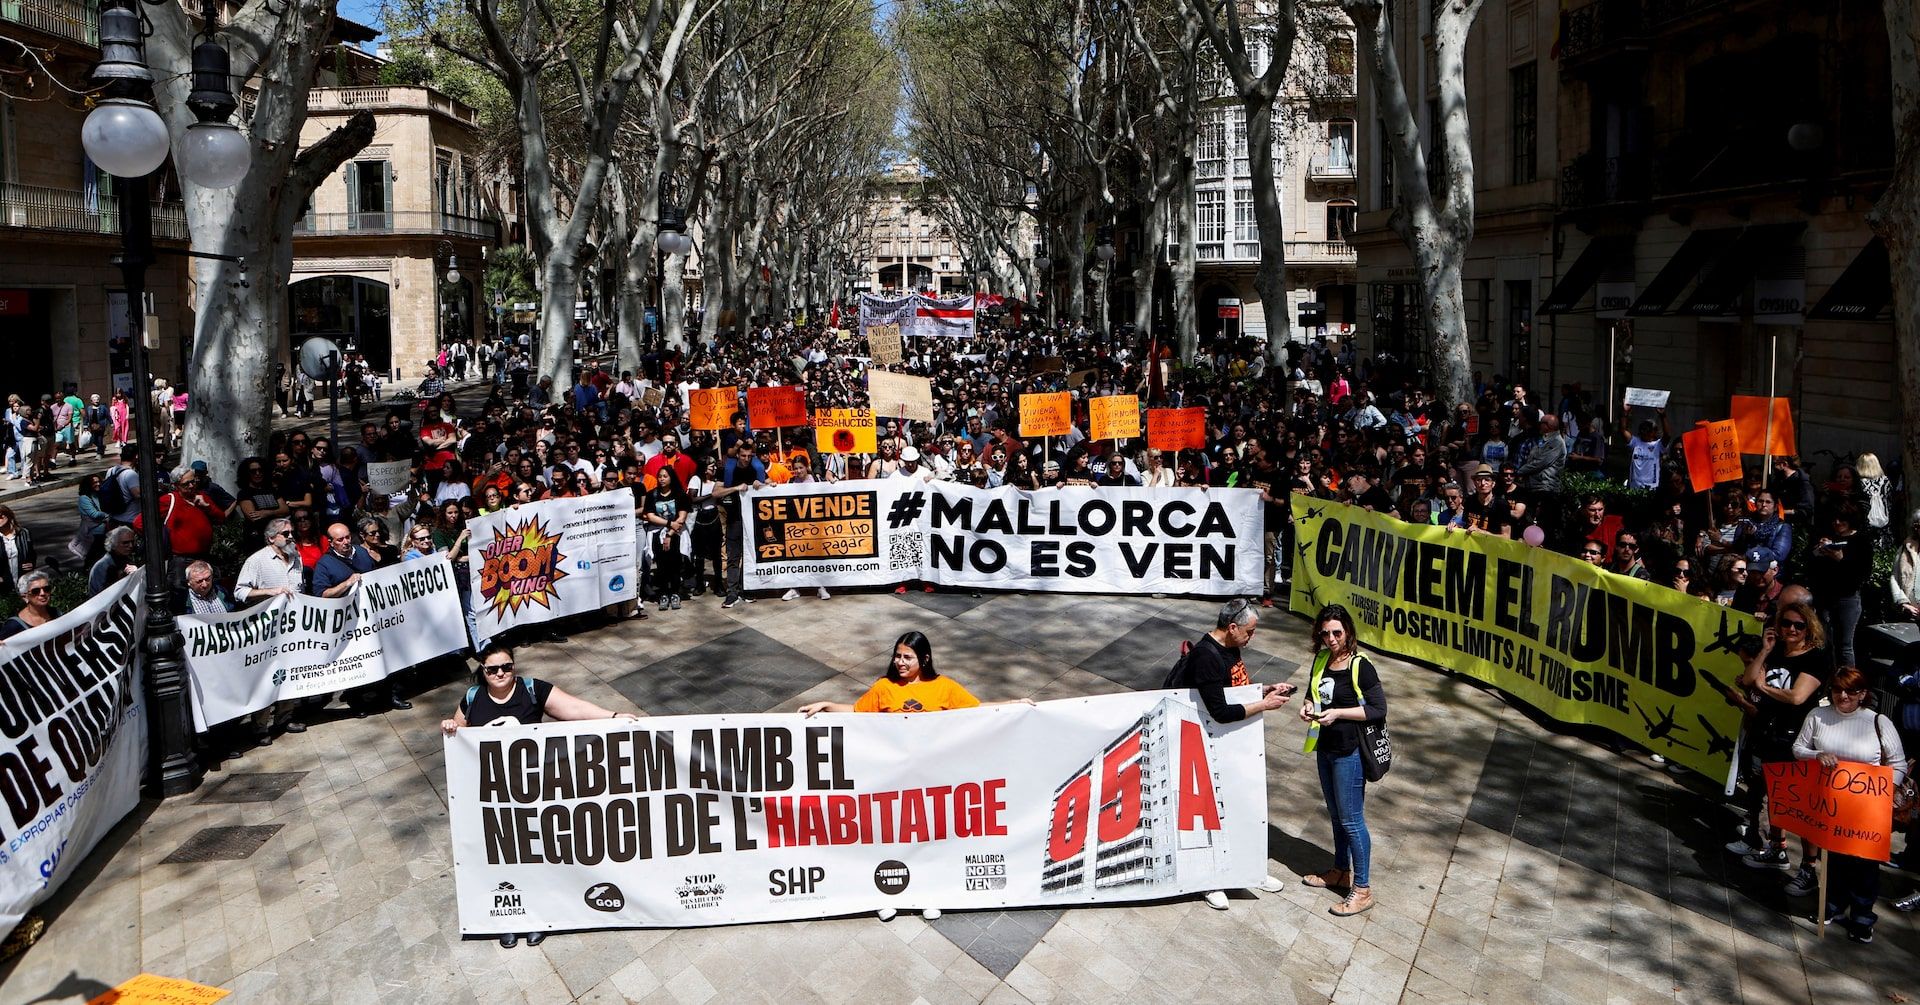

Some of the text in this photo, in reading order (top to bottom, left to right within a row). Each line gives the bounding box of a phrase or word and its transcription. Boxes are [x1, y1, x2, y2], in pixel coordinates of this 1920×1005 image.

[1601, 296, 1631, 307] OYSHO
[1759, 297, 1799, 311] OYSHO
[881, 344, 899, 352] GENTE
[690, 388, 738, 407] CONTROL
[704, 413, 724, 425] YA
[753, 406, 778, 417] DIGNA
[820, 409, 832, 417] NO
[851, 409, 870, 418] LOS
[817, 418, 874, 428] DESAHUCIOS
[1711, 452, 1737, 463] ECHO
[758, 494, 871, 521] SE VENDE
[886, 491, 1237, 539] #MALLORCA
[823, 524, 843, 536] no
[849, 521, 870, 536] ho
[486, 535, 524, 560] OVER
[822, 537, 866, 556] pagar
[930, 533, 1236, 581] NO ES VEN
[481, 543, 558, 597] BOOM
[755, 561, 880, 576] mallorcanoesven.com
[510, 575, 547, 596] KING
[302, 605, 328, 634] UN
[365, 582, 385, 614] NO
[384, 582, 402, 607] un
[400, 563, 449, 602] NEGOCI
[1315, 518, 1697, 698] CANVIEM EL RUMB
[1364, 611, 1378, 628] VIDA
[244, 645, 278, 667] barris
[281, 638, 329, 653] contra
[1382, 604, 1630, 715] POSEM LÍMITS AL TURISME
[326, 667, 337, 676] DE
[338, 662, 363, 673] PALMA
[479, 726, 855, 804] ACABEM AMB EL
[0, 734, 64, 831] DE
[1177, 719, 1222, 831] A
[1767, 761, 1890, 797] UN HOGAR
[1771, 780, 1838, 818] ES UN
[10, 802, 68, 853] EXPROPIAR
[67, 780, 90, 808] CASES
[481, 778, 1008, 867] NEGOCI DE L'HABITATGE
[1773, 801, 1882, 843] DERECHO HUMANO
[965, 854, 1005, 864] MALLORCA
[685, 873, 716, 885] STOP
[967, 866, 1004, 876] NO ES
[768, 866, 826, 897] SHP
[887, 878, 903, 886] VIDA
[966, 879, 991, 890] VEN
[494, 894, 522, 908] PAH
[595, 899, 621, 908] GOB
[685, 901, 720, 911] MALLORCA
[489, 907, 527, 917] MALLORCA
